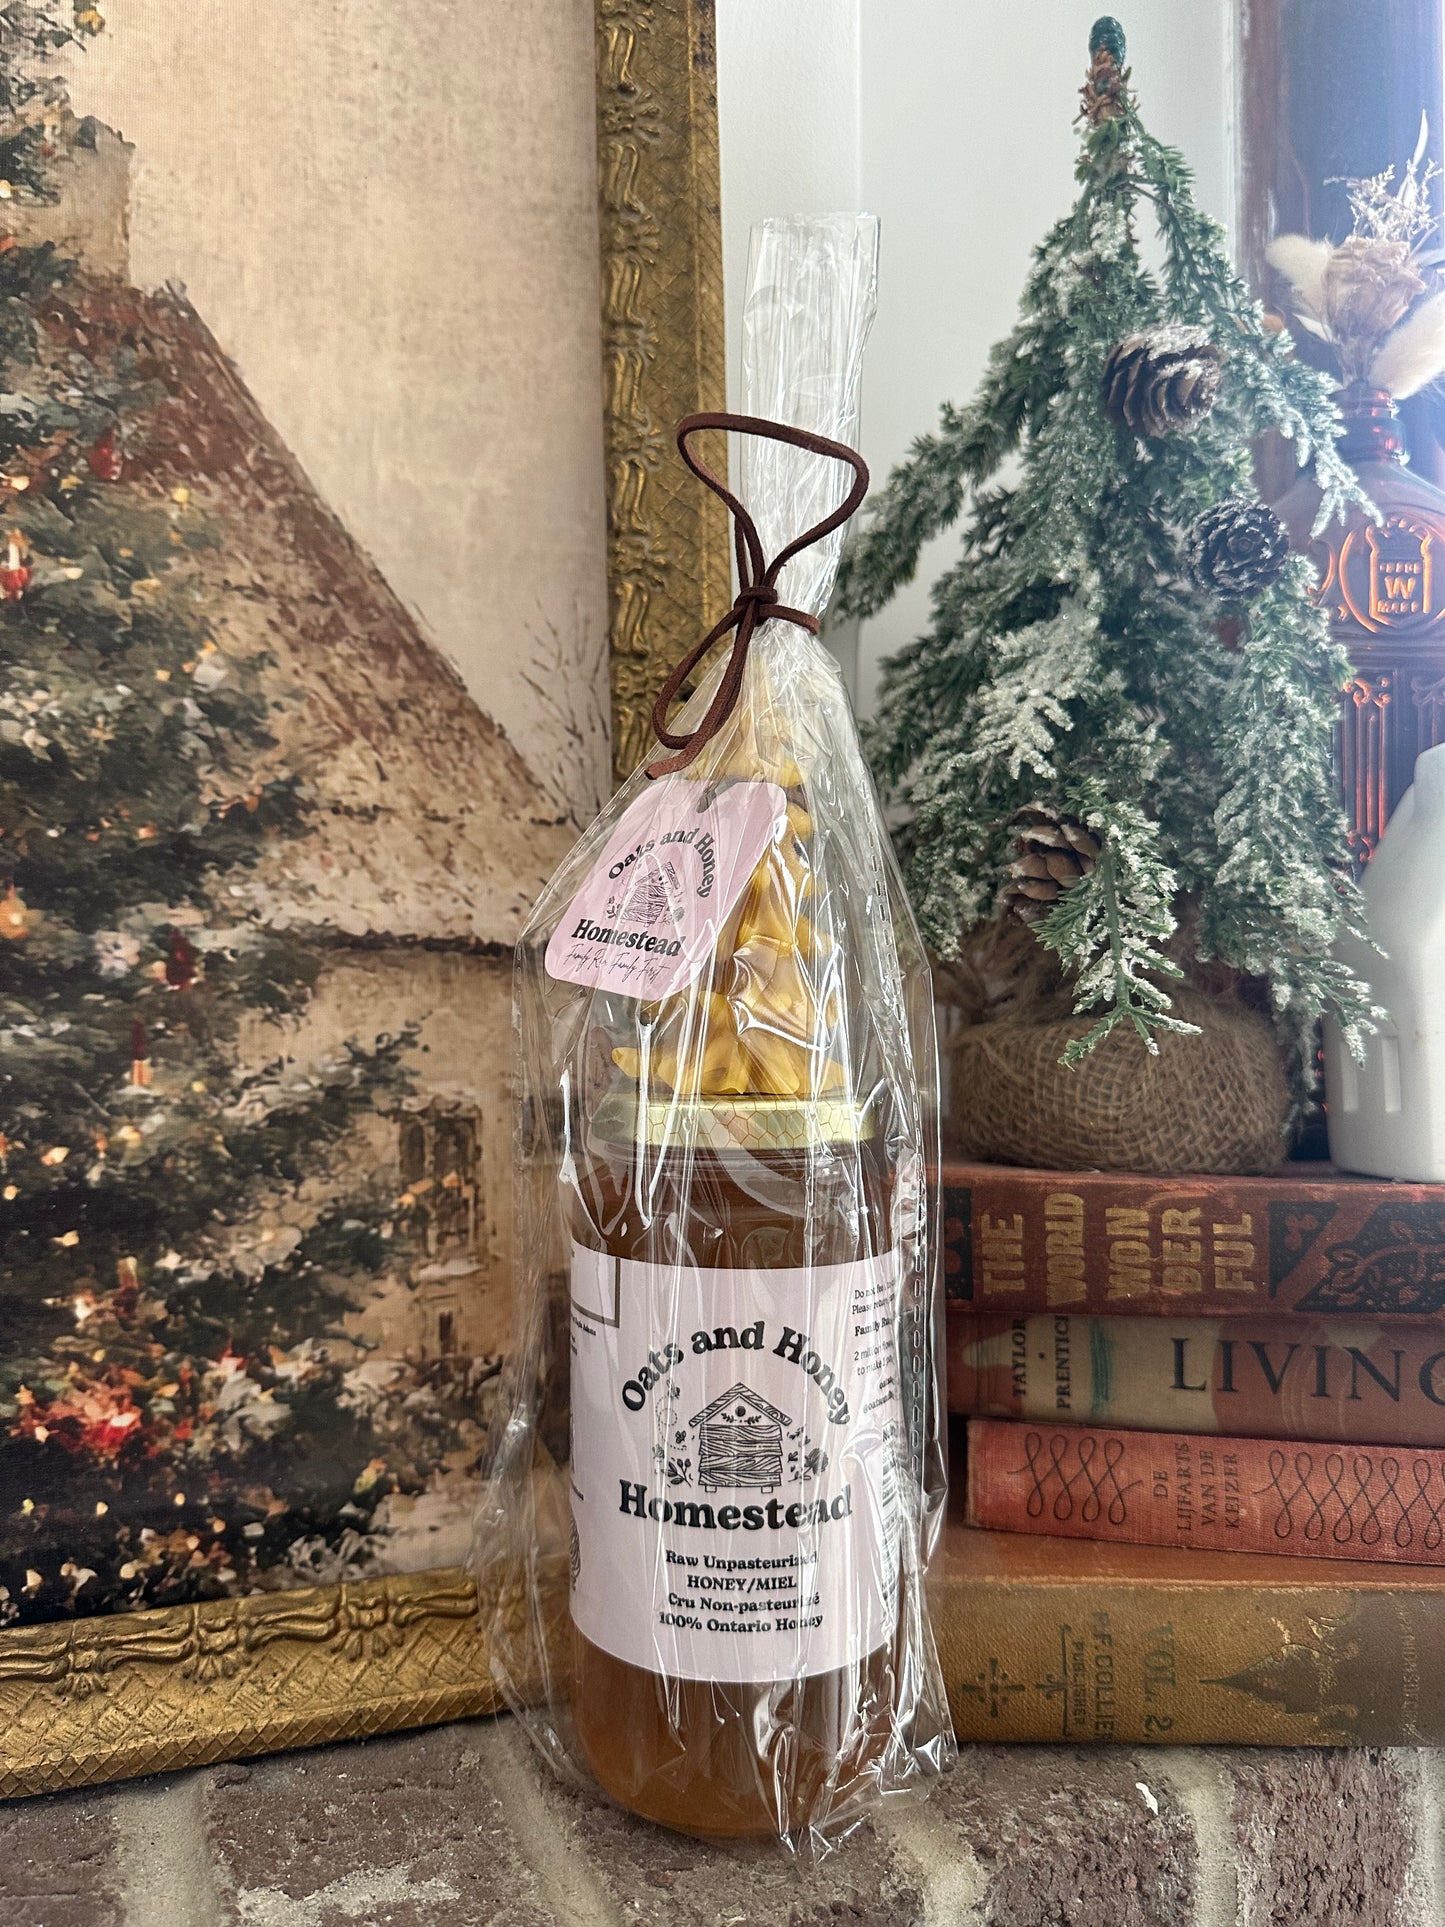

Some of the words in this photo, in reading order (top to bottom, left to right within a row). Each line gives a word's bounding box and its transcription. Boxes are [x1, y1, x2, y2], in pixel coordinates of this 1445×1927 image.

[1384, 576, 1416, 599] W
[608, 839, 655, 880] Oats
[660, 827, 700, 845] and
[694, 832, 716, 899] Honey
[571, 918, 687, 957] Homestead
[980, 1213, 1026, 1295] THE
[1044, 1192, 1087, 1306] WORLD
[1105, 1206, 1152, 1299] WON
[1161, 1206, 1202, 1294] DER
[1213, 1212, 1257, 1292] FUL
[622, 1341, 685, 1412] Oats
[690, 1320, 766, 1355] and
[772, 1326, 851, 1426] Honey
[1012, 1318, 1027, 1398] TAYLOR
[1153, 1470, 1169, 1498] DE
[1200, 1450, 1215, 1476] DE
[618, 1479, 853, 1530] Homestead
[1200, 1483, 1217, 1526] VAN
[1223, 1453, 1240, 1529] KEIZER
[665, 1550, 699, 1566] Raw
[668, 1592, 696, 1609] Cru
[687, 1574, 797, 1594] HONEY/MIEL
[658, 1611, 703, 1630] 100%
[706, 1618, 772, 1633] Ontario
[775, 1614, 824, 1631] Honey
